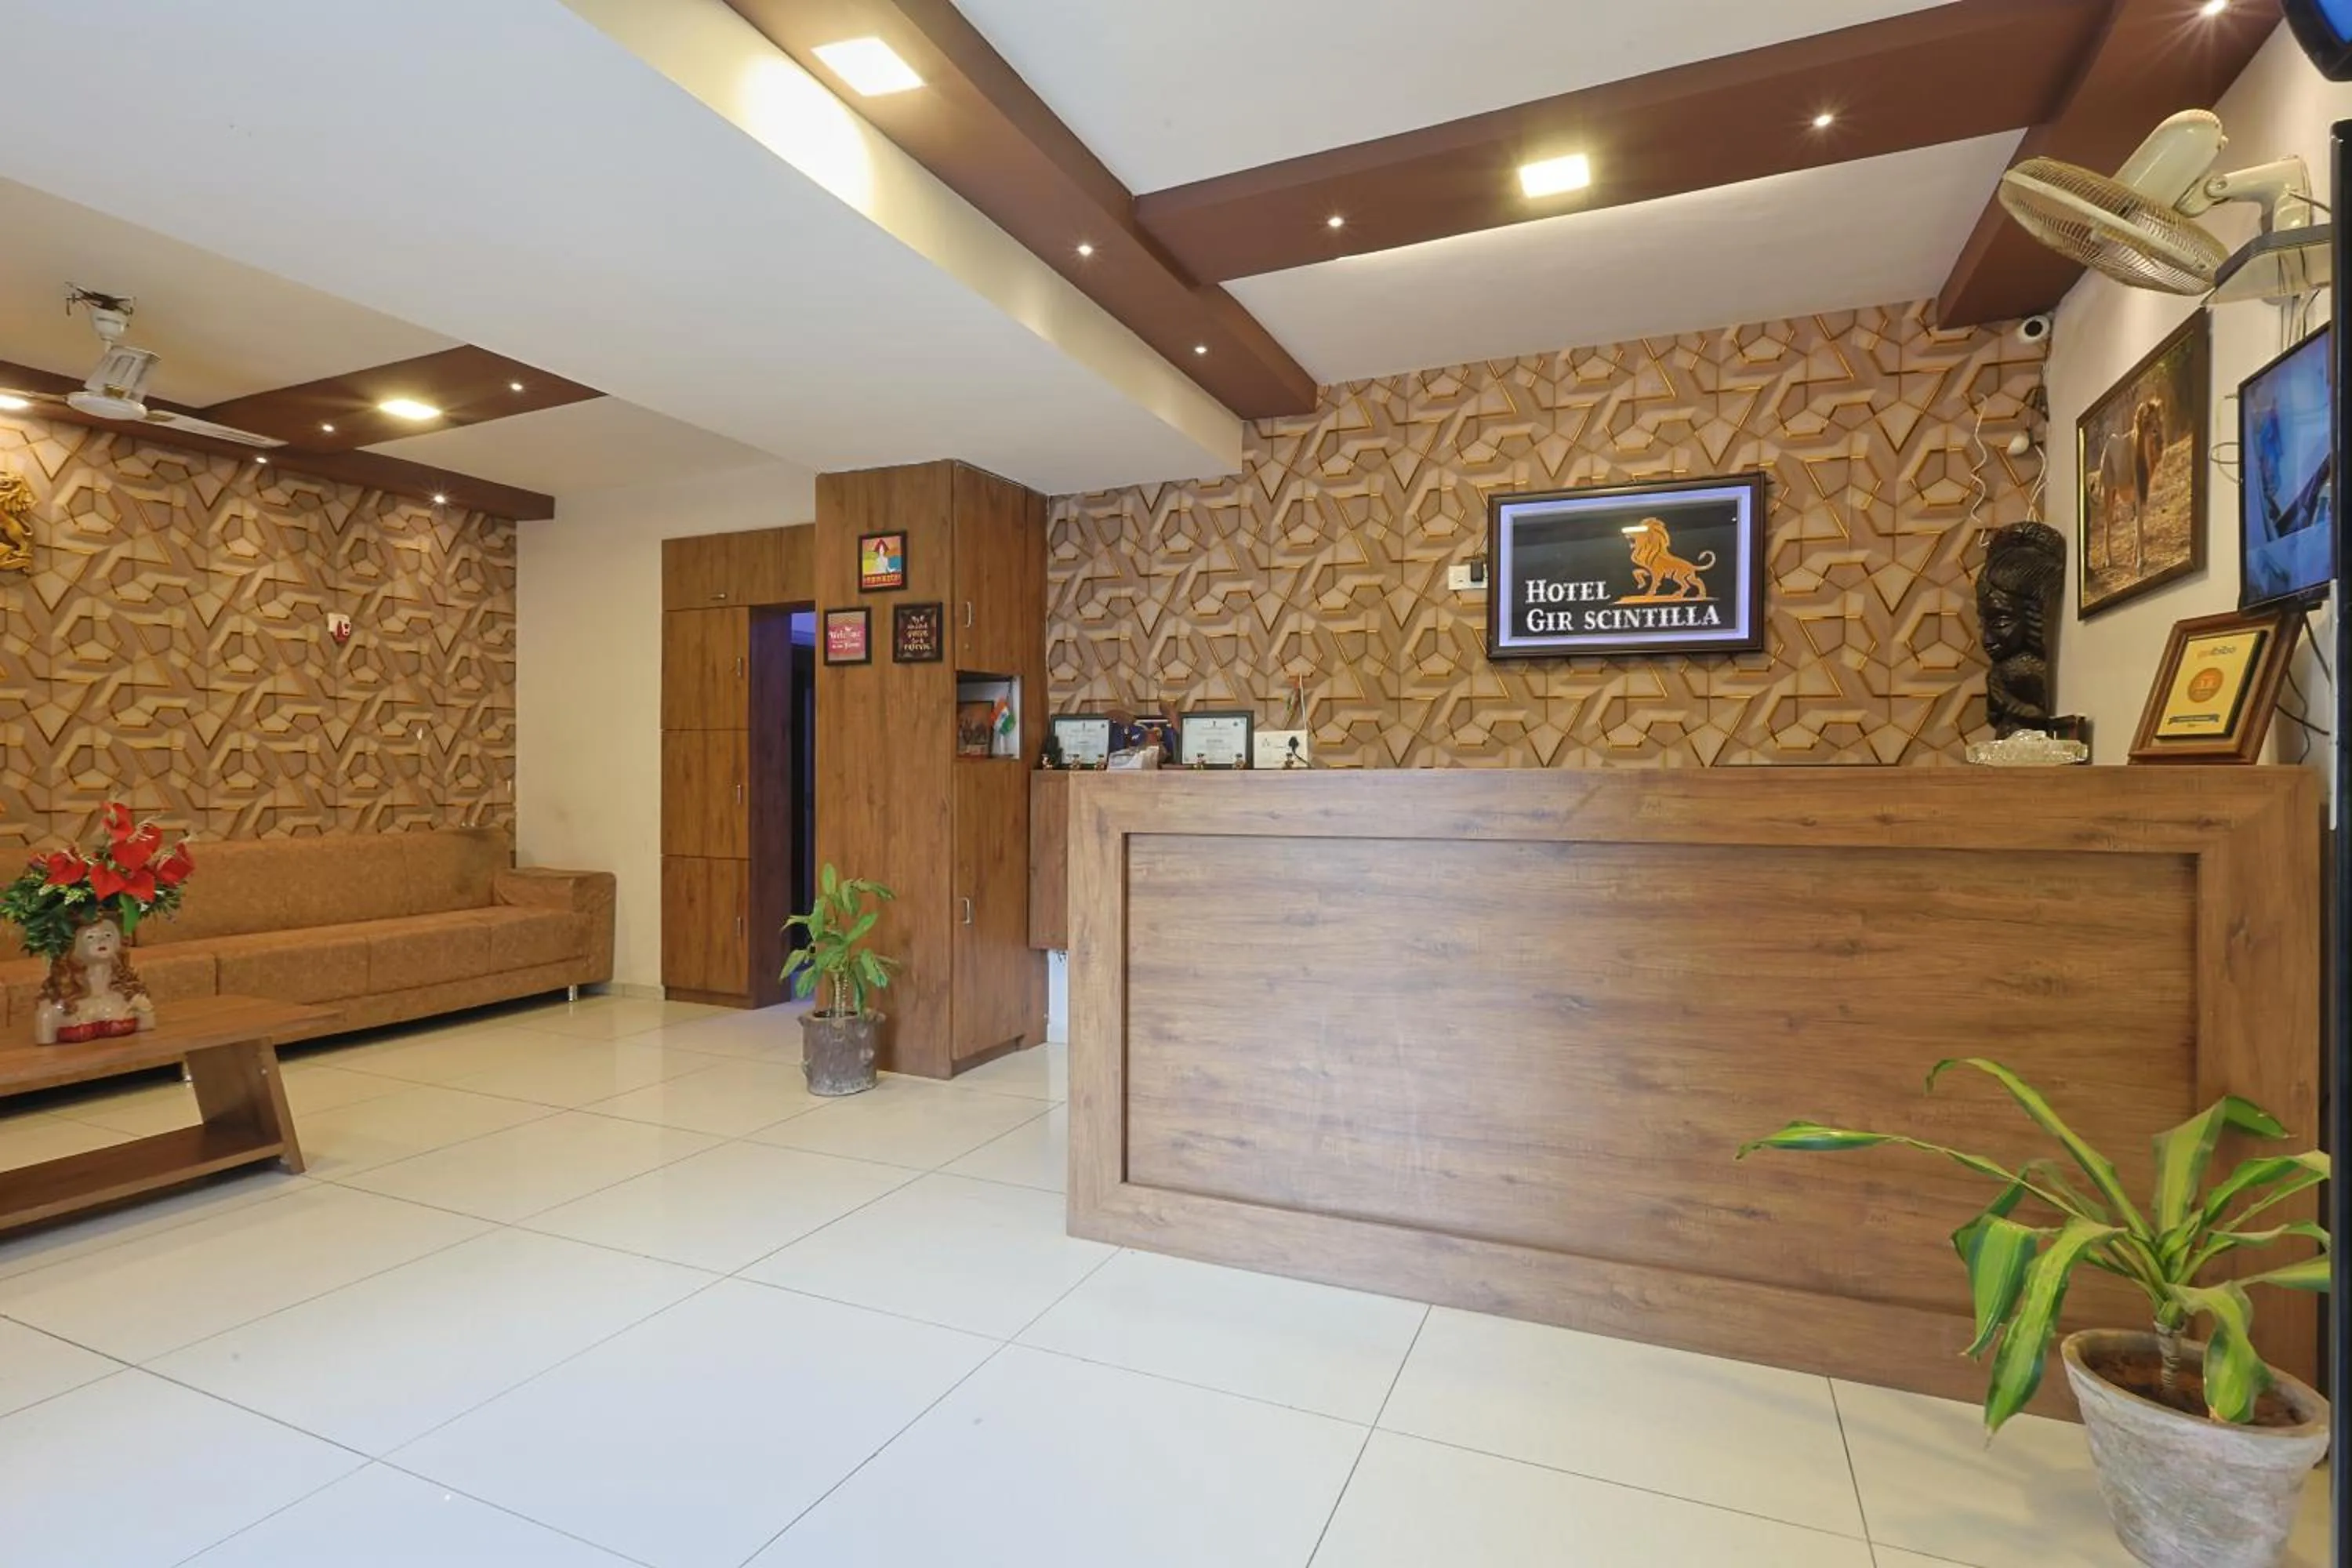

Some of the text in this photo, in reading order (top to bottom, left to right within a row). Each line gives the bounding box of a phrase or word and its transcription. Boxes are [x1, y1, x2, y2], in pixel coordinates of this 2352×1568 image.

[1525, 579, 1610, 604] HOTEL
[1526, 604, 1721, 632] GIR SCINTILLA
